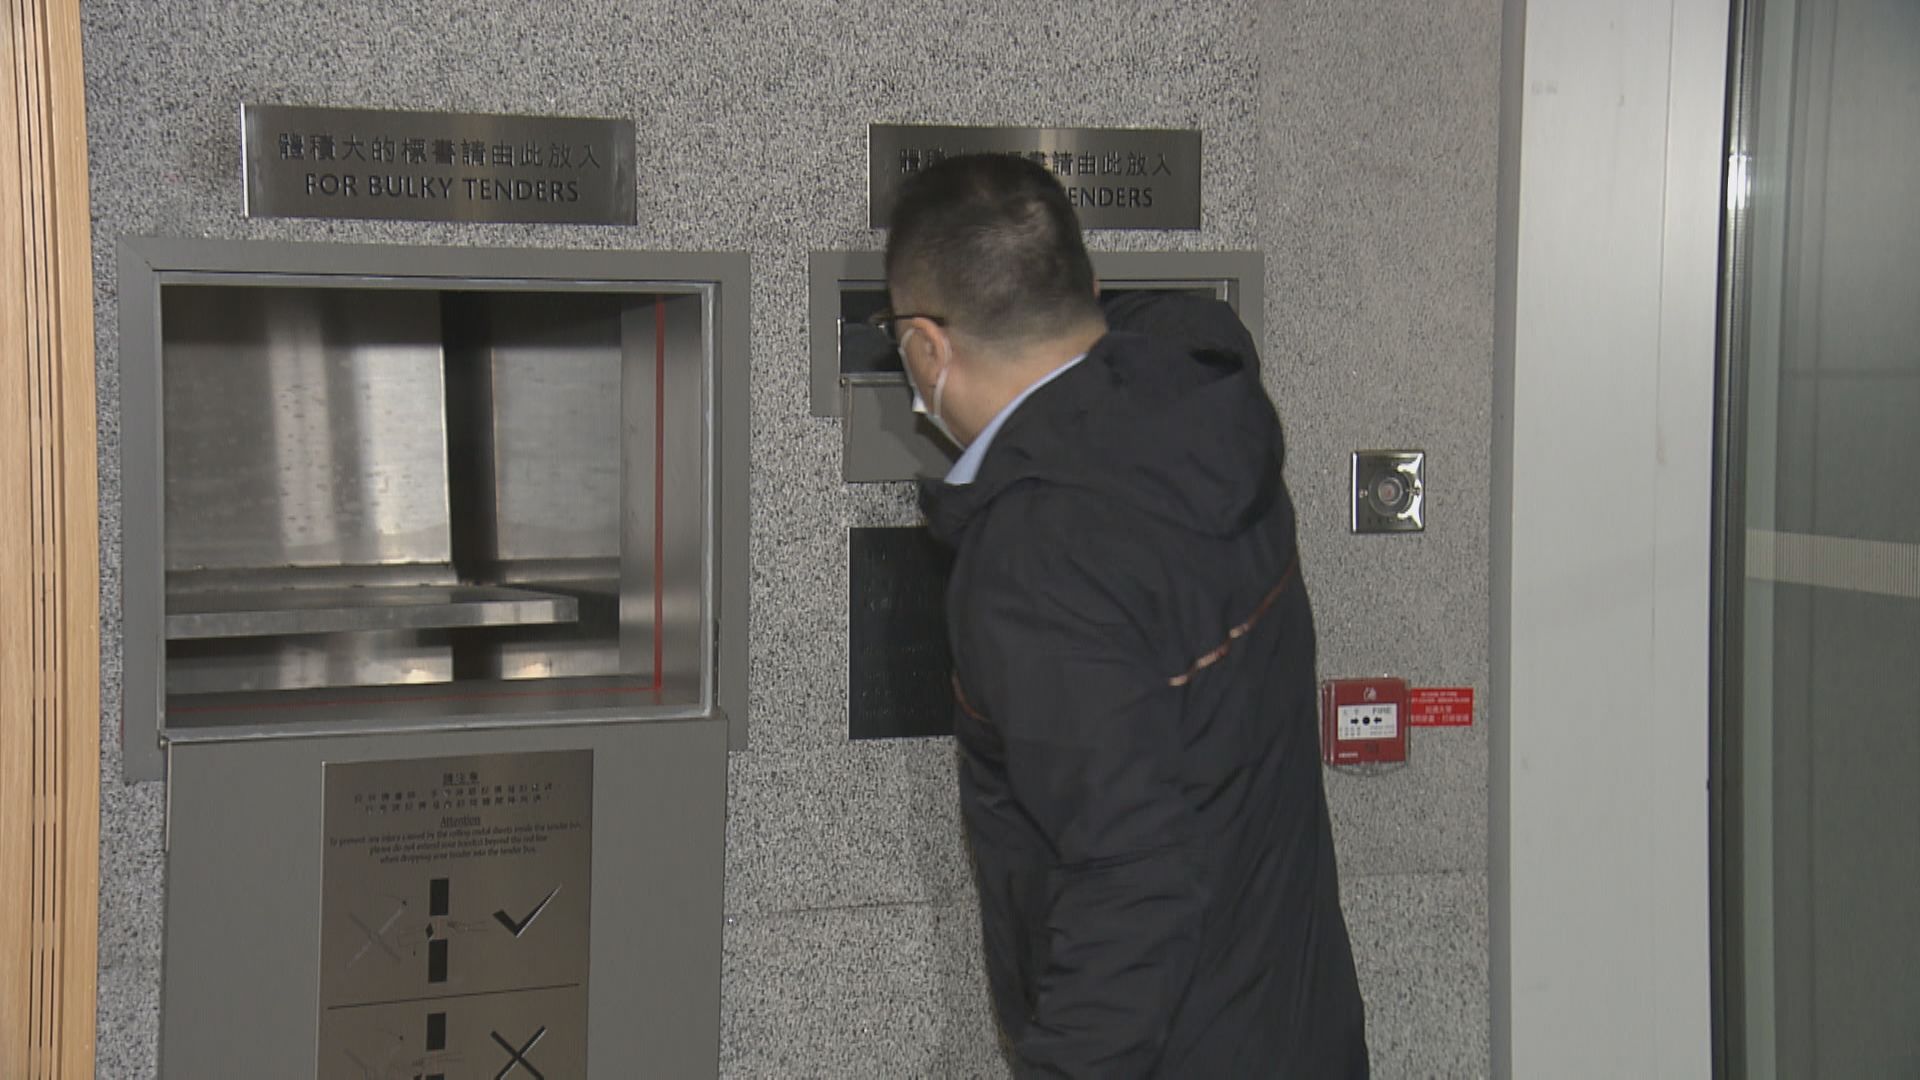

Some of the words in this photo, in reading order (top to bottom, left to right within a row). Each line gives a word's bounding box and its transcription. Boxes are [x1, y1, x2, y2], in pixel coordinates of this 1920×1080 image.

[306, 173, 358, 197] FOR
[368, 174, 453, 200] BULKY
[462, 177, 579, 203] TENDERS
[1063, 186, 1153, 208] ENDERS
